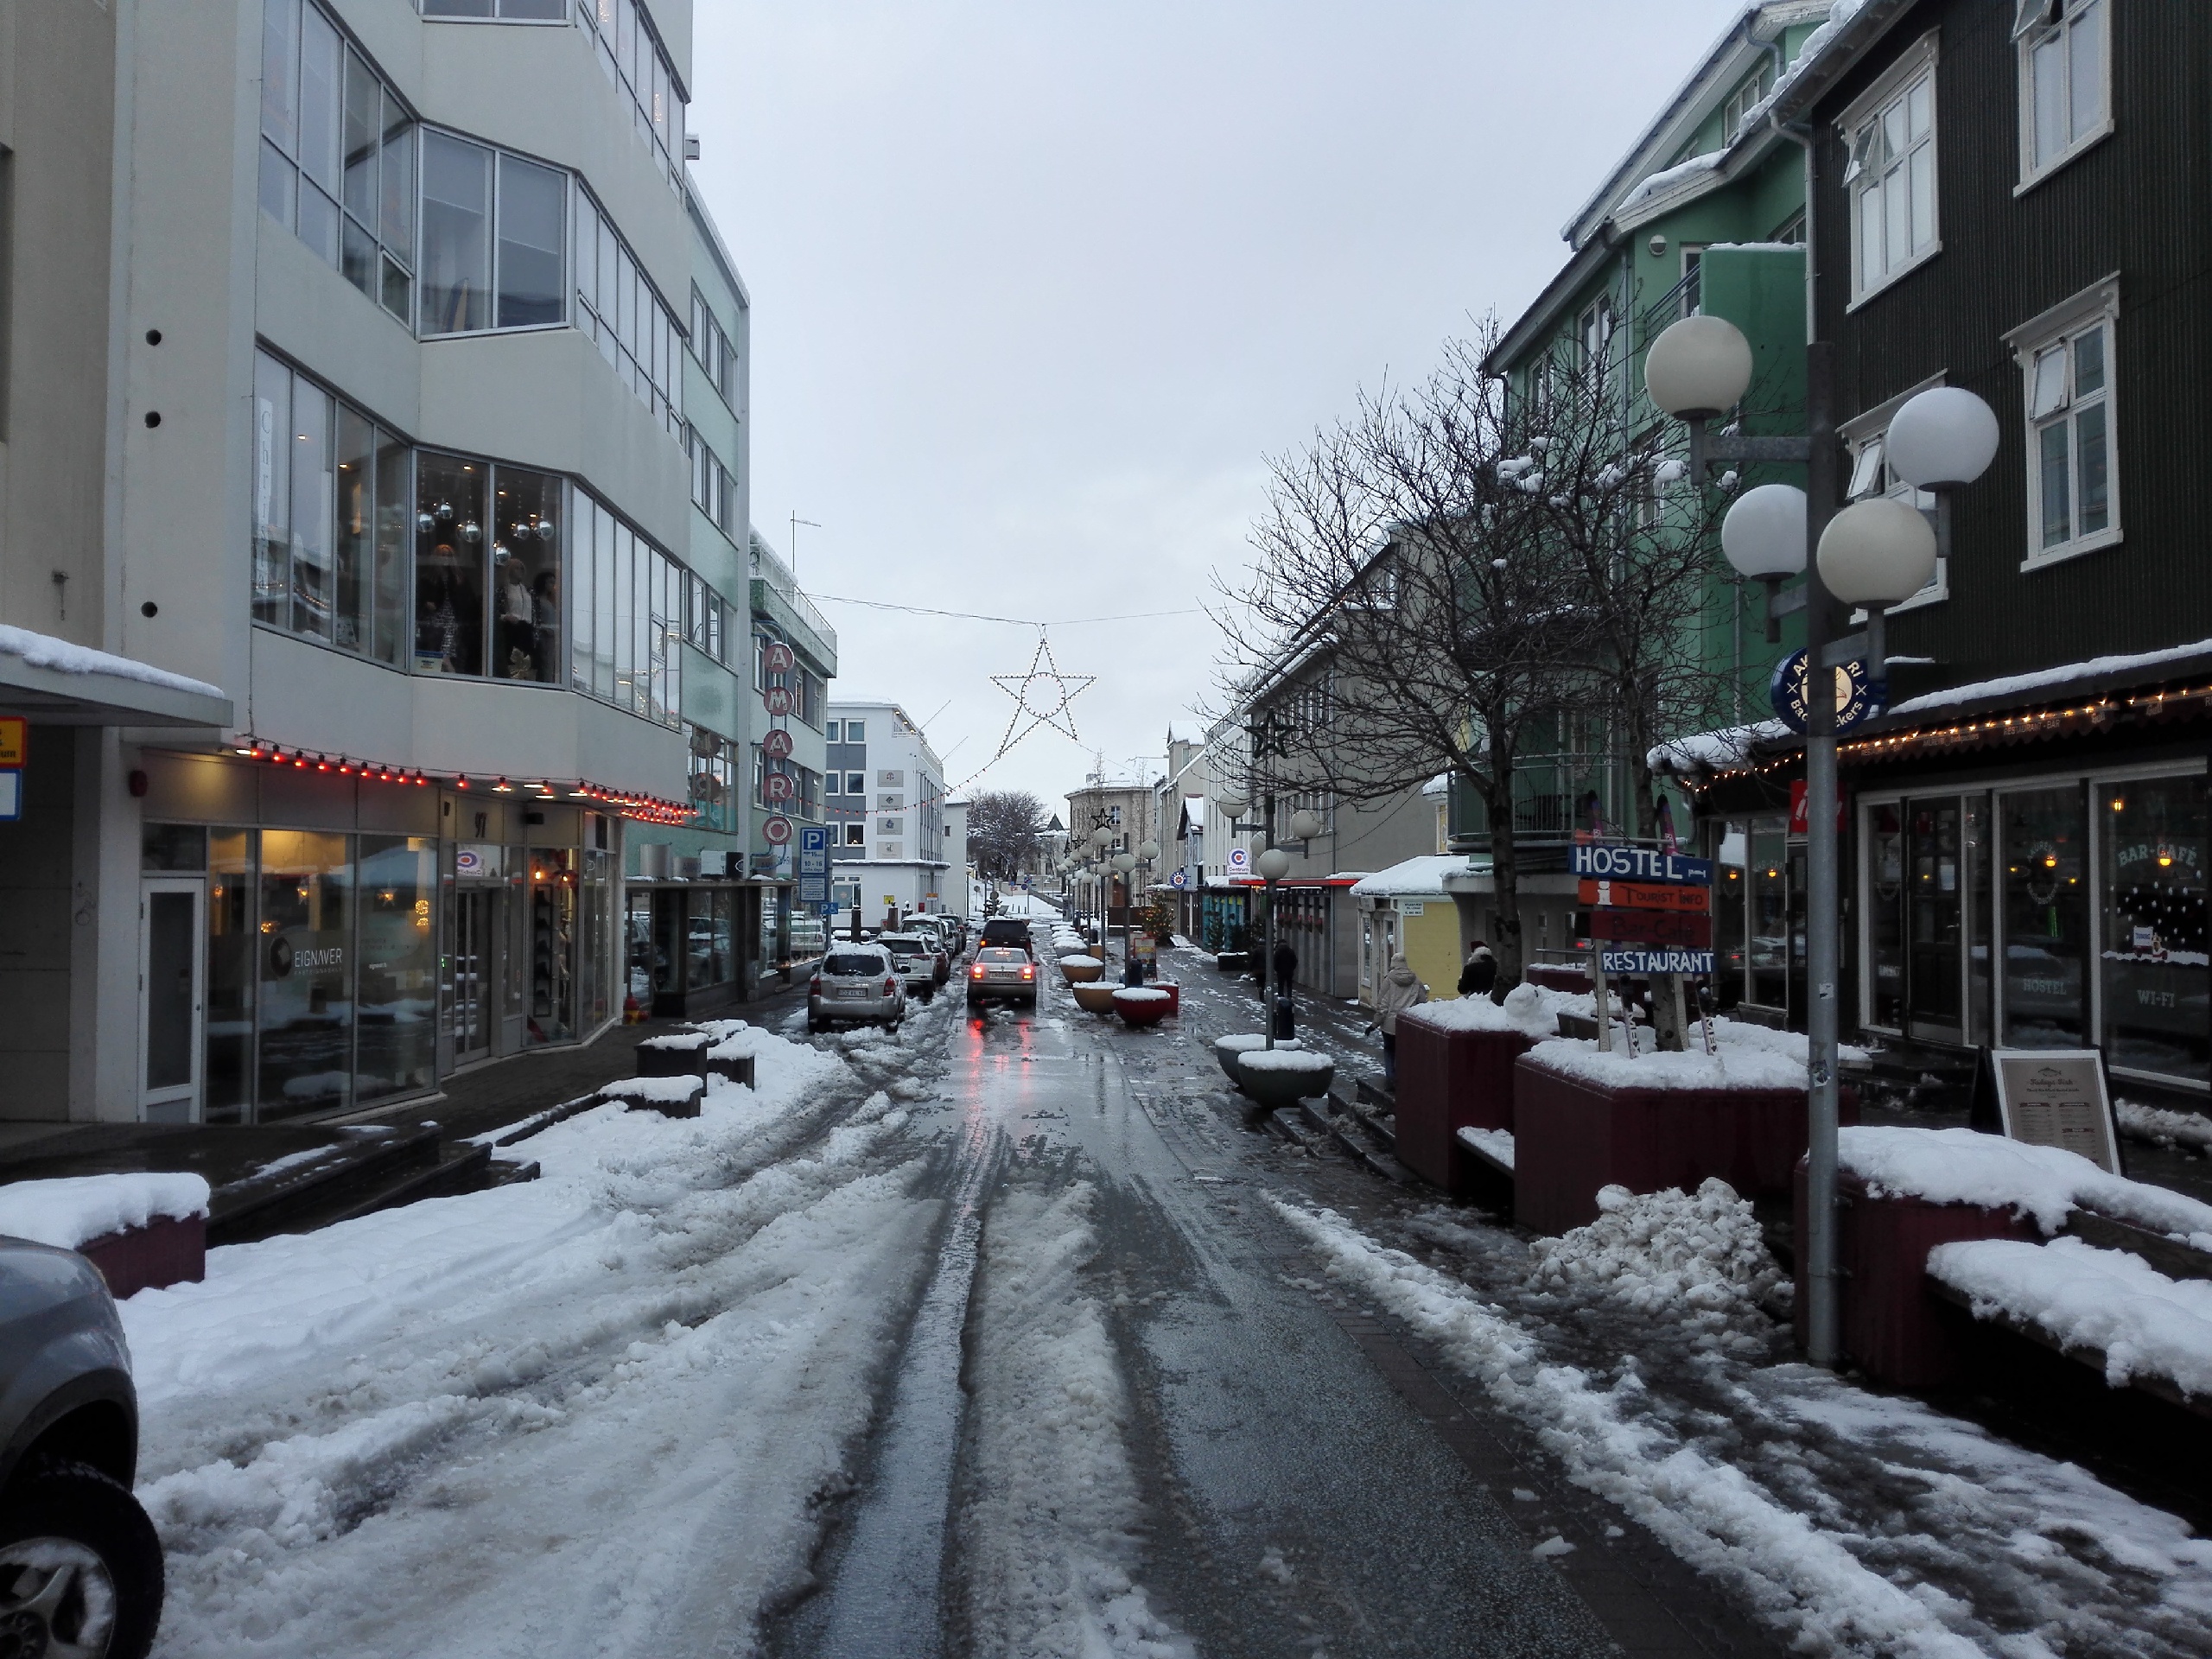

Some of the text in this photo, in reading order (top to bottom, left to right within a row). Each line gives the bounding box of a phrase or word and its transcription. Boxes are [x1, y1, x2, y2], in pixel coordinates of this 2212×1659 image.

[2004, 722, 2041, 735] RESTAURANT
[2047, 720, 2061, 729] BAR
[768, 646, 789, 842] AMARO
[1576, 846, 1683, 880] HOSTEL
[295, 948, 342, 968] EIGNAVER
[1602, 951, 1714, 972] RESTAURANT
[2023, 978, 2067, 995] HOSTEL
[2137, 989, 2175, 1008] WI-FI
